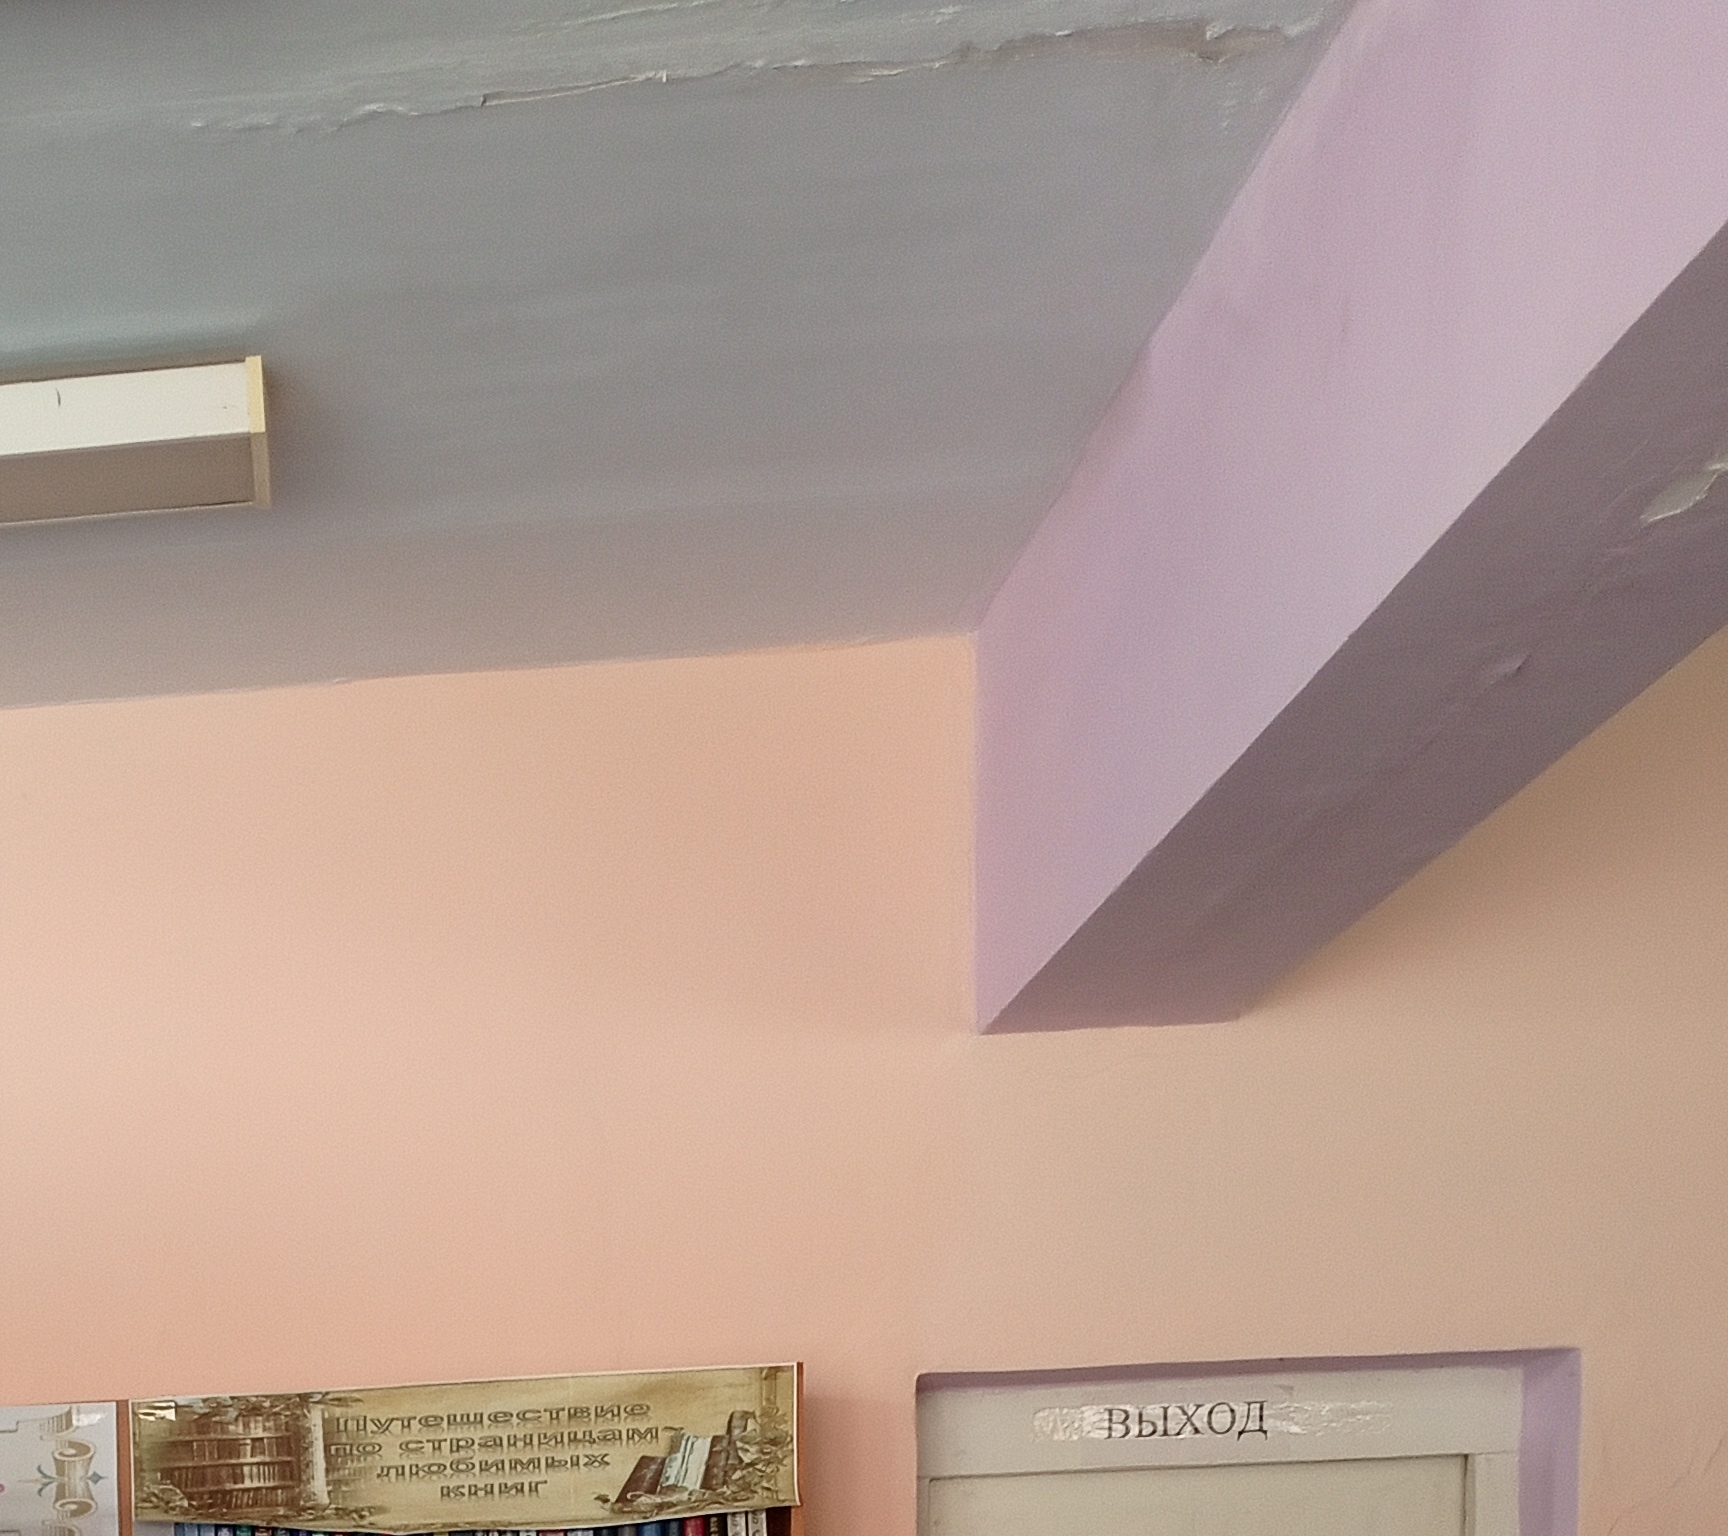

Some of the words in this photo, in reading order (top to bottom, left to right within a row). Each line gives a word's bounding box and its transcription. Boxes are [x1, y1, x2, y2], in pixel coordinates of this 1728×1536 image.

[335, 1402, 651, 1434] Путешествие
[1104, 1400, 1269, 1442] ВЫХОД
[330, 1440, 383, 1457] по
[399, 1426, 661, 1453] страницам
[376, 1453, 611, 1478] любимых
[440, 1479, 549, 1498] книг
